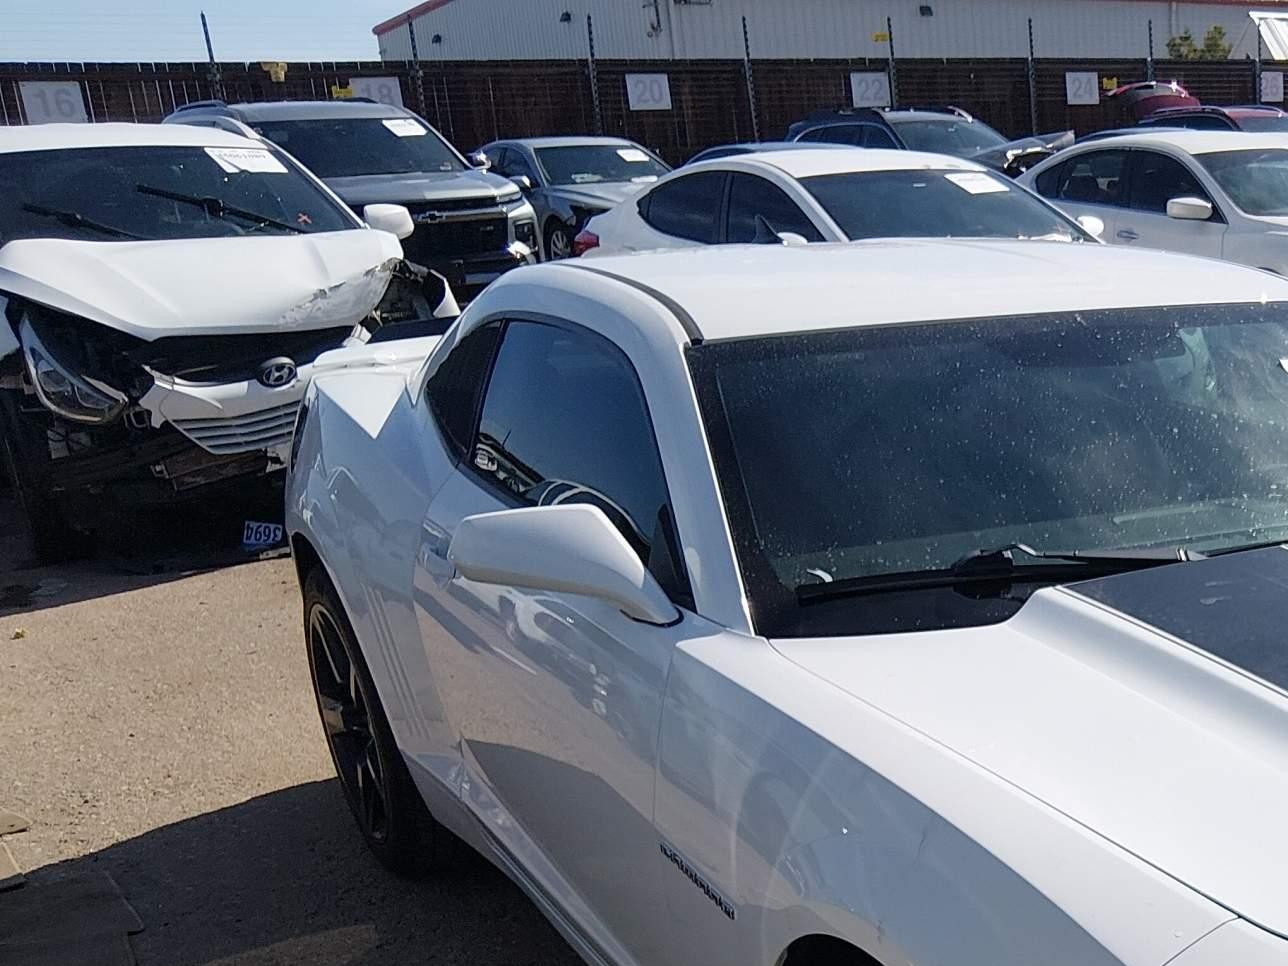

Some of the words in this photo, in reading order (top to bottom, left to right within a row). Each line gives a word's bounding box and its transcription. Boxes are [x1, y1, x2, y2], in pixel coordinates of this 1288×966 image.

[634, 79, 664, 104] 20
[858, 79, 884, 102] 22
[1071, 78, 1094, 99] 24
[33, 88, 75, 118] 16
